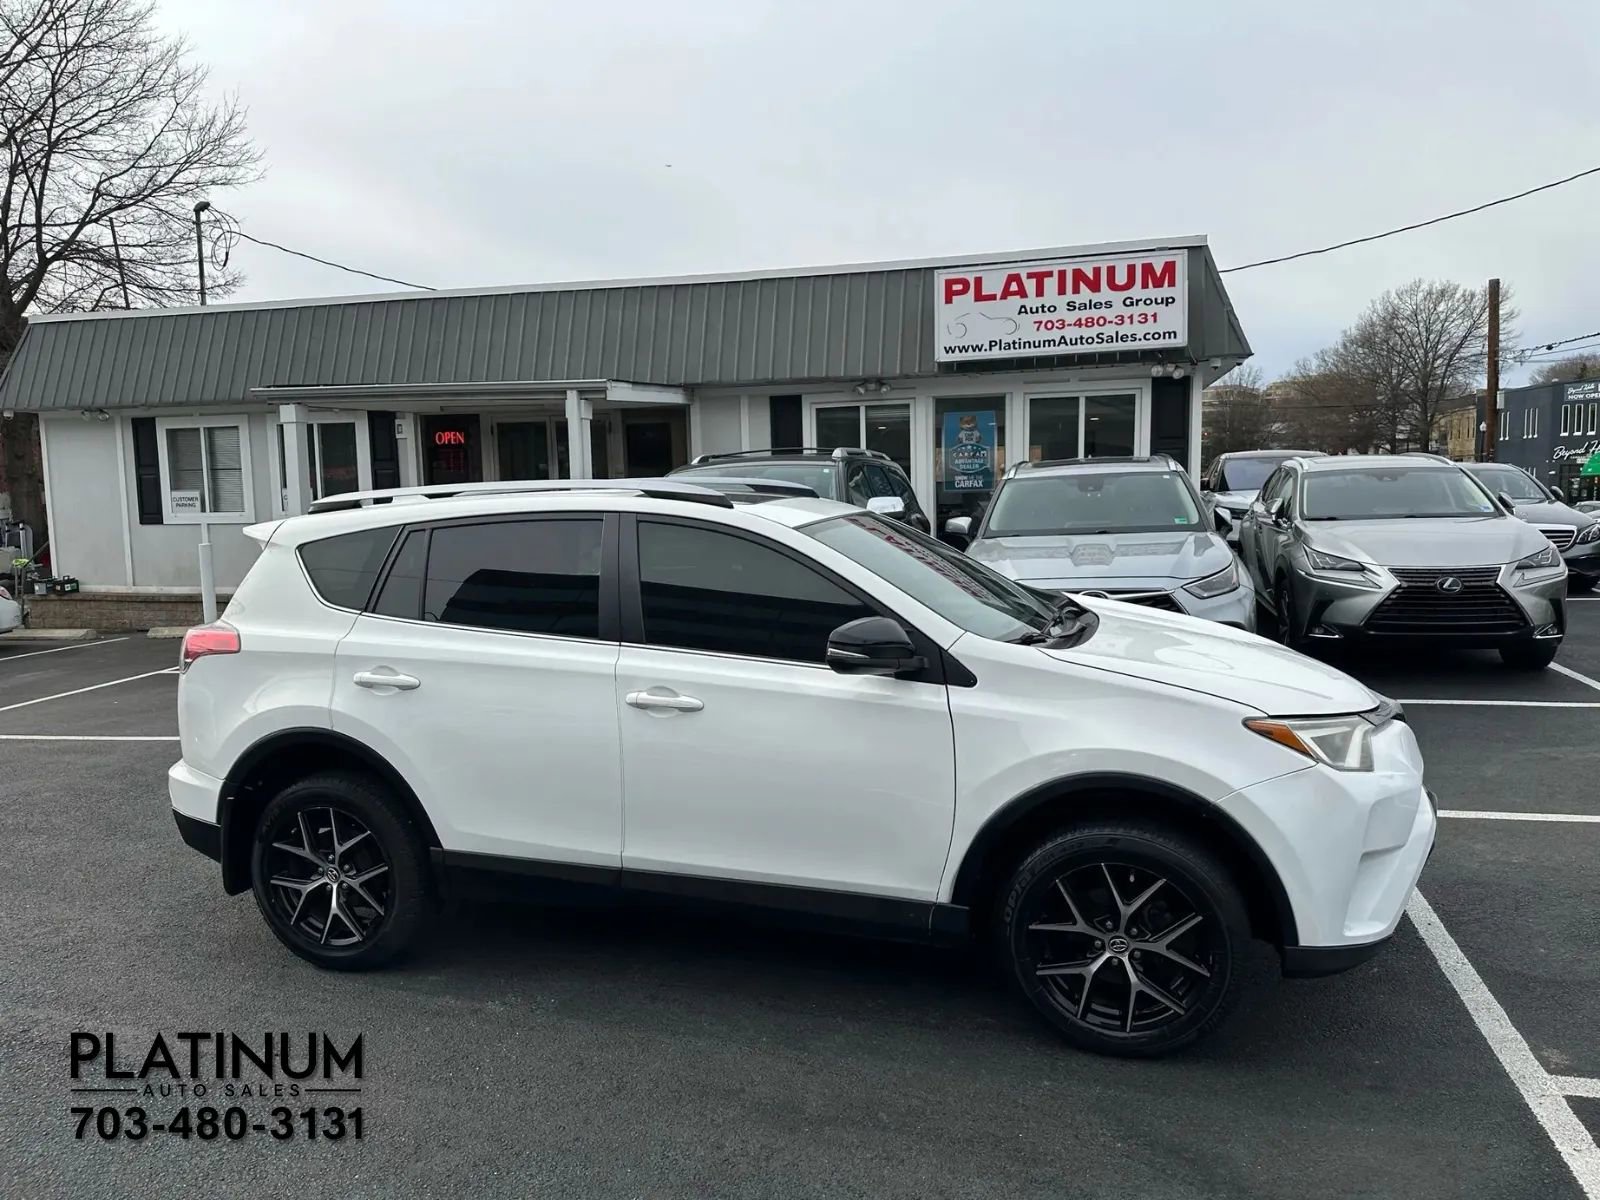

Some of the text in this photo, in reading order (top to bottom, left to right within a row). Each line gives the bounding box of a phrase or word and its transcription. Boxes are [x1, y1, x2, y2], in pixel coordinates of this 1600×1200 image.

[944, 260, 1177, 305] PLATINUM
[1017, 295, 1177, 316] Auto Sales Group
[1033, 312, 1159, 332] 703-480-3131
[944, 329, 1178, 355] www.PlatinumAutoSales.com
[1585, 392, 1600, 400] OPE
[435, 431, 465, 445] OPEN
[1553, 442, 1589, 460] Beyond
[954, 480, 983, 488] CARFAX
